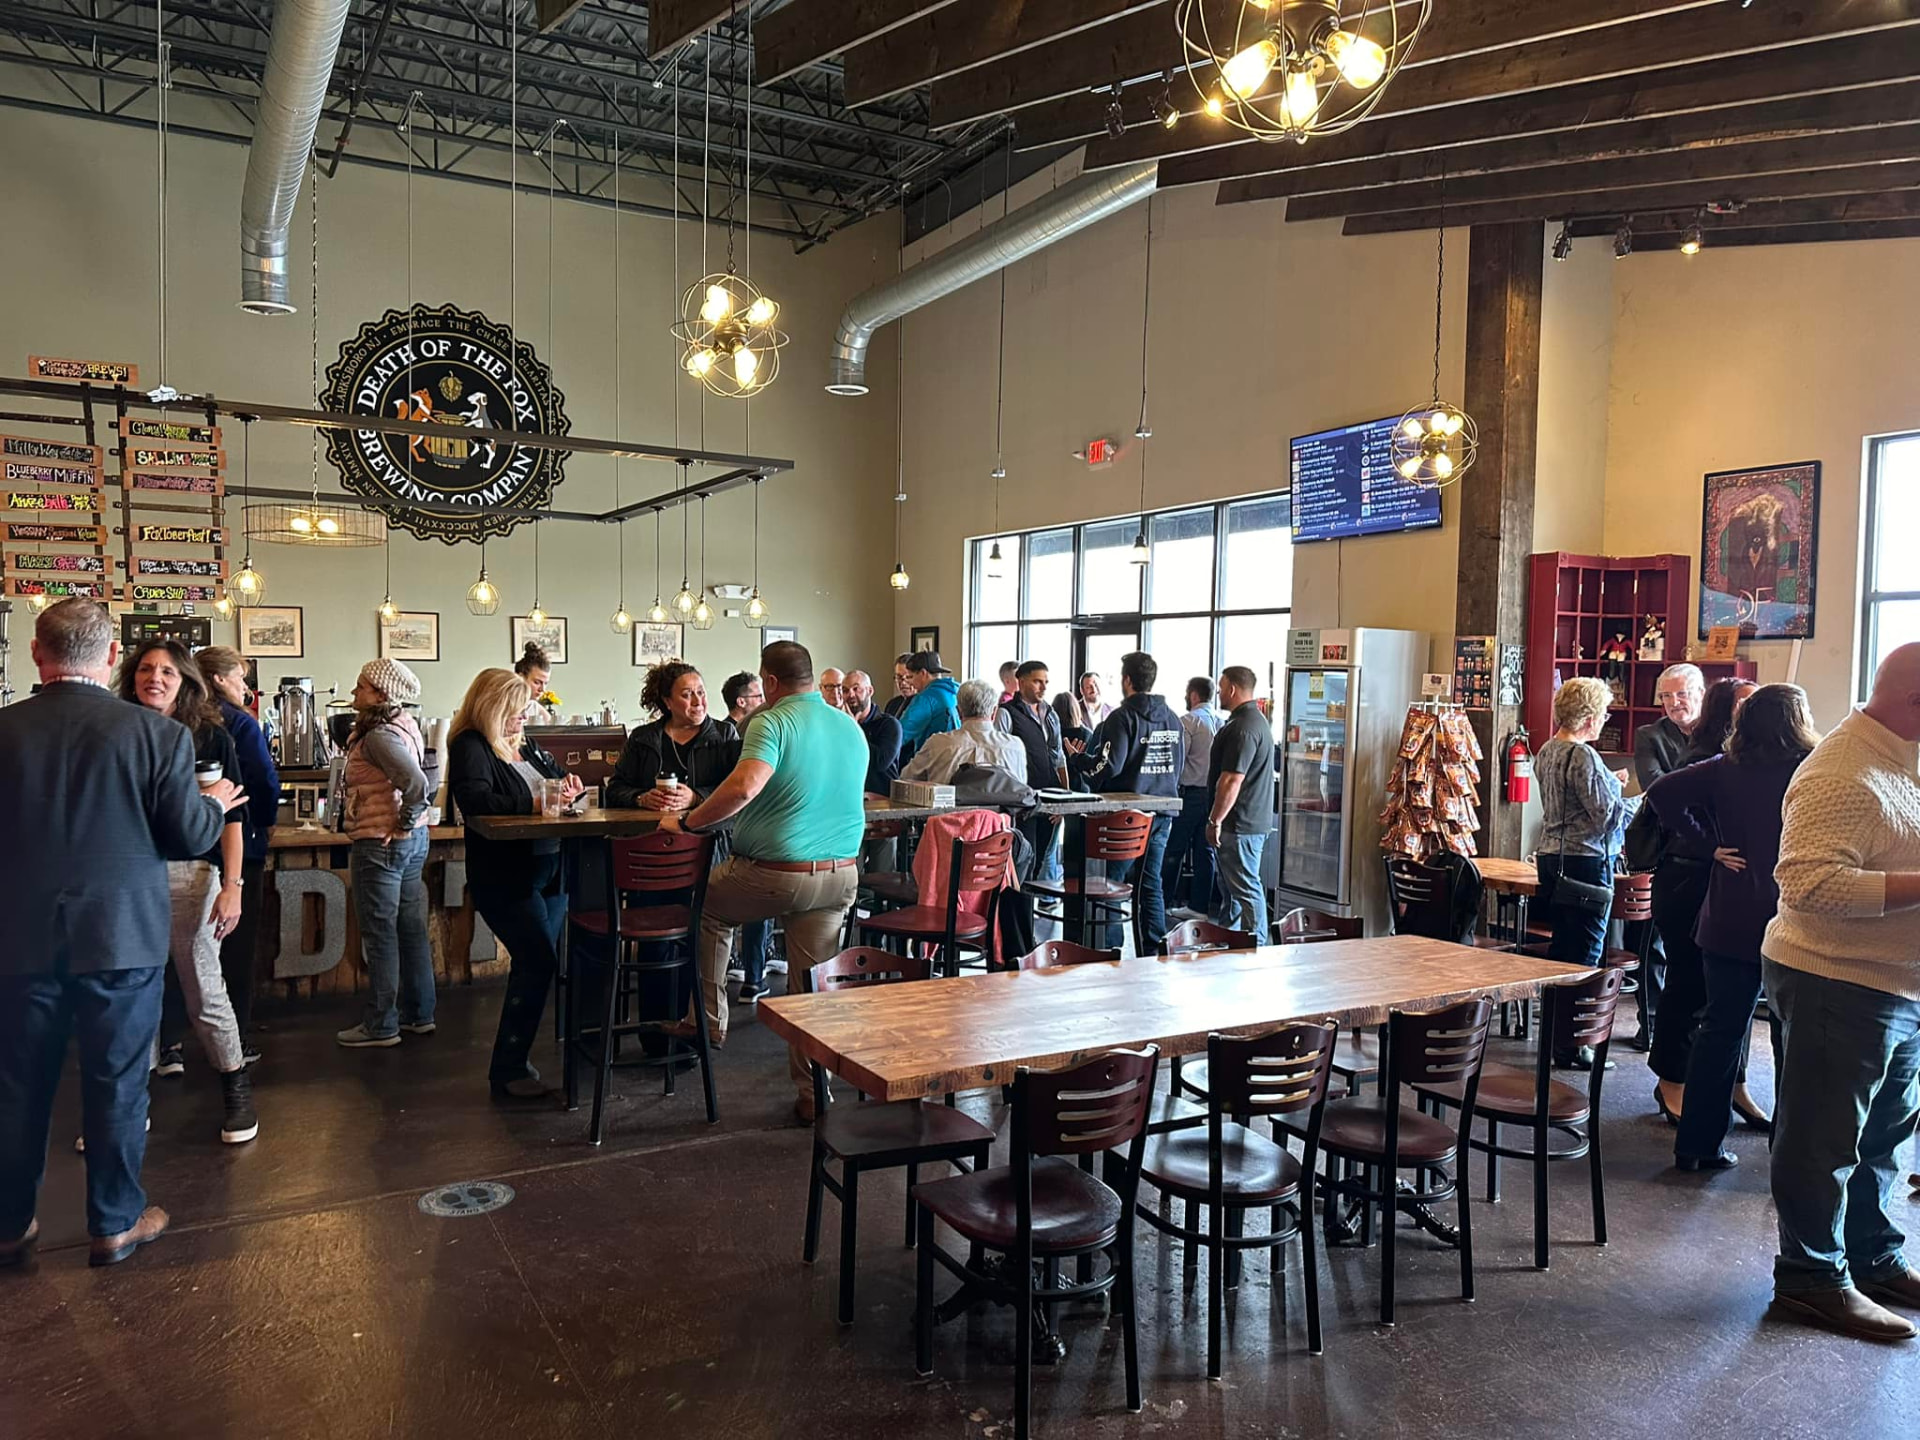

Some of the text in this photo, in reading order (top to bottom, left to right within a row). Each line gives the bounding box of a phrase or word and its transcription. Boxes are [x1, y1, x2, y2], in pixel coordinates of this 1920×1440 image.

[365, 336, 382, 351] NJ
[390, 319, 510, 351] EMBRACE THE CHASE
[357, 339, 537, 424] DEATH OF THE FOX
[54, 468, 94, 484] MUFFIN
[450, 445, 536, 507] COMPAN
[484, 483, 541, 527] ESTABHED
